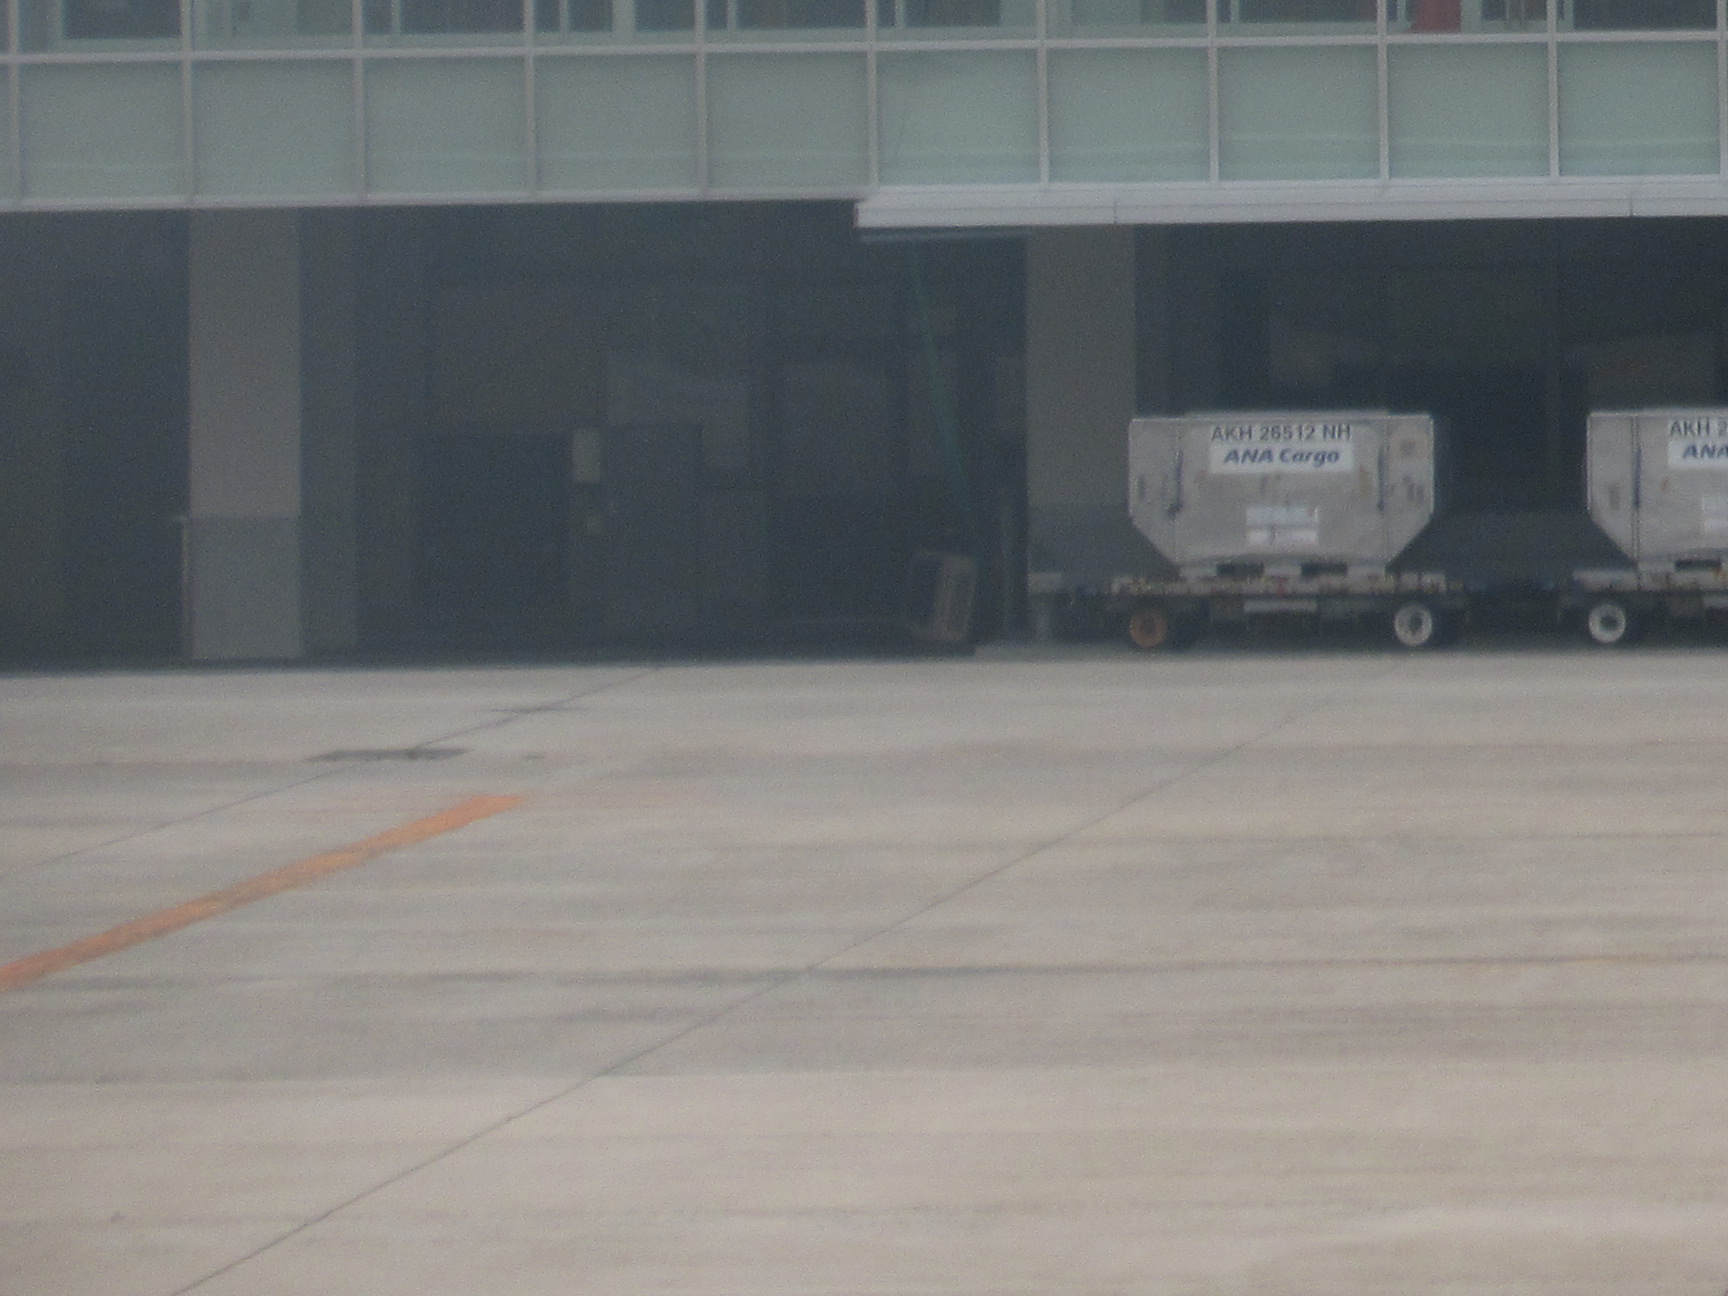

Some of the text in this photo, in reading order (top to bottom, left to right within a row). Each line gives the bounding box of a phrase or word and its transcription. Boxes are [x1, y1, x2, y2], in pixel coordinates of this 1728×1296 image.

[1211, 425, 1253, 442] AKH
[1323, 424, 1351, 441] NH
[1669, 418, 1710, 436] AKH
[1224, 448, 1340, 467] ANA Cargo
